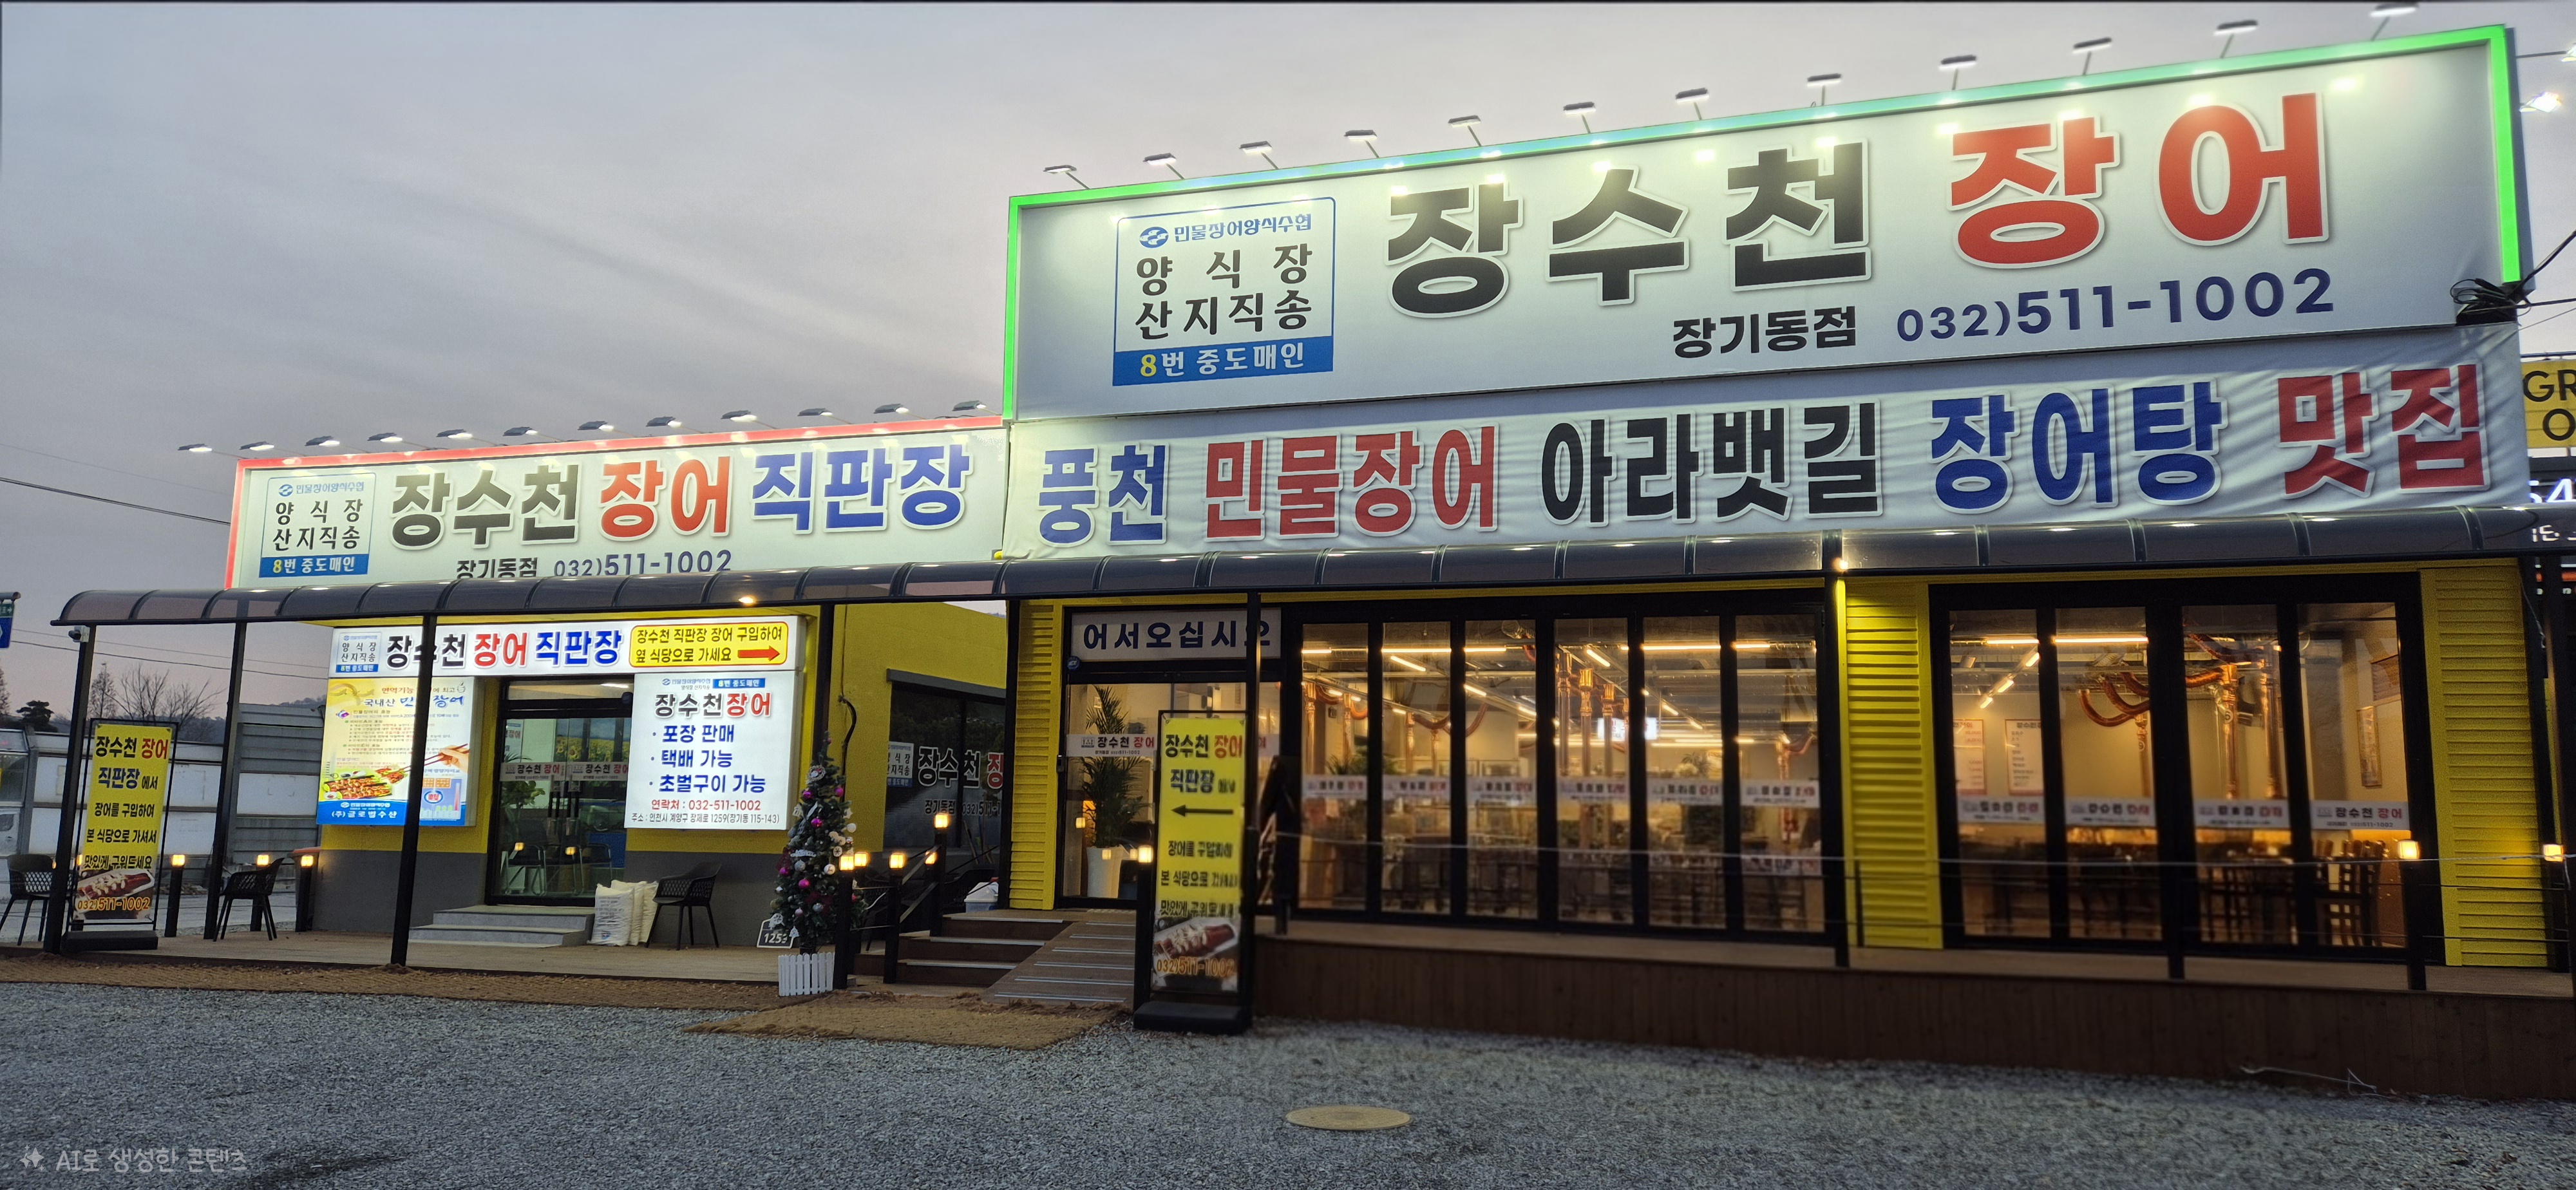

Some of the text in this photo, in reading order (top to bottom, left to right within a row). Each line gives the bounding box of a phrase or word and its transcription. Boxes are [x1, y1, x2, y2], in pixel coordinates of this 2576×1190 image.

[1388, 92, 2324, 315] 장수천 장어
[1174, 213, 1312, 243] 민물장어양식수협
[1135, 288, 1312, 340] 산지직송
[1674, 268, 2334, 359] 장기동점 032)511-1002
[1141, 342, 1305, 377] 8번 중도매인
[1038, 364, 2485, 543] 풍천 민물장어 아라뱃길 장어탕 맛집
[296, 482, 365, 494] 민물장어양식수협
[392, 444, 969, 545] 장수천 장어 직판장
[272, 525, 361, 551] 산지직송
[273, 556, 355, 574] 8번 중도매인
[456, 549, 732, 578] 장기동점 032)511-1002
[637, 626, 782, 643] 장수천 직판장 장어 구입하여
[474, 632, 527, 666] 장어
[536, 630, 621, 665] 직판장
[636, 647, 731, 663] 옆 식당으로 가세요
[364, 695, 464, 708] 국내산 민장어
[655, 693, 771, 717] 장수천 장어
[663, 724, 734, 743] 포장 판매
[1097, 737, 1129, 748] 장수천
[1134, 737, 1155, 748] 장어
[96, 736, 169, 759] 장수천 장어
[1165, 734, 1242, 758] 장수천 장어
[517, 764, 560, 773] 장수천 장어
[585, 764, 610, 773] 장수천
[661, 750, 733, 768] 택배 가능
[918, 746, 980, 788] 장수천
[98, 767, 158, 789] 직판장 에서
[659, 774, 766, 793] 초벌구이 가능
[1170, 769, 1215, 793] 직판장
[95, 802, 155, 818] 장어를 구입하여
[651, 800, 679, 810] 연락처
[688, 800, 761, 810] 032-511-1002
[2336, 807, 2402, 818] 장수천 장어
[631, 813, 644, 822] 주소
[649, 813, 668, 822] 인천시
[669, 813, 688, 823] 계양구
[86, 829, 157, 844] 본 식당으로 가셔서
[1168, 840, 1194, 857] 장어를
[84, 855, 152, 869] 맛있게 구워드세요
[1161, 871, 1170, 886] 본
[1173, 871, 1208, 887] 식당으로
